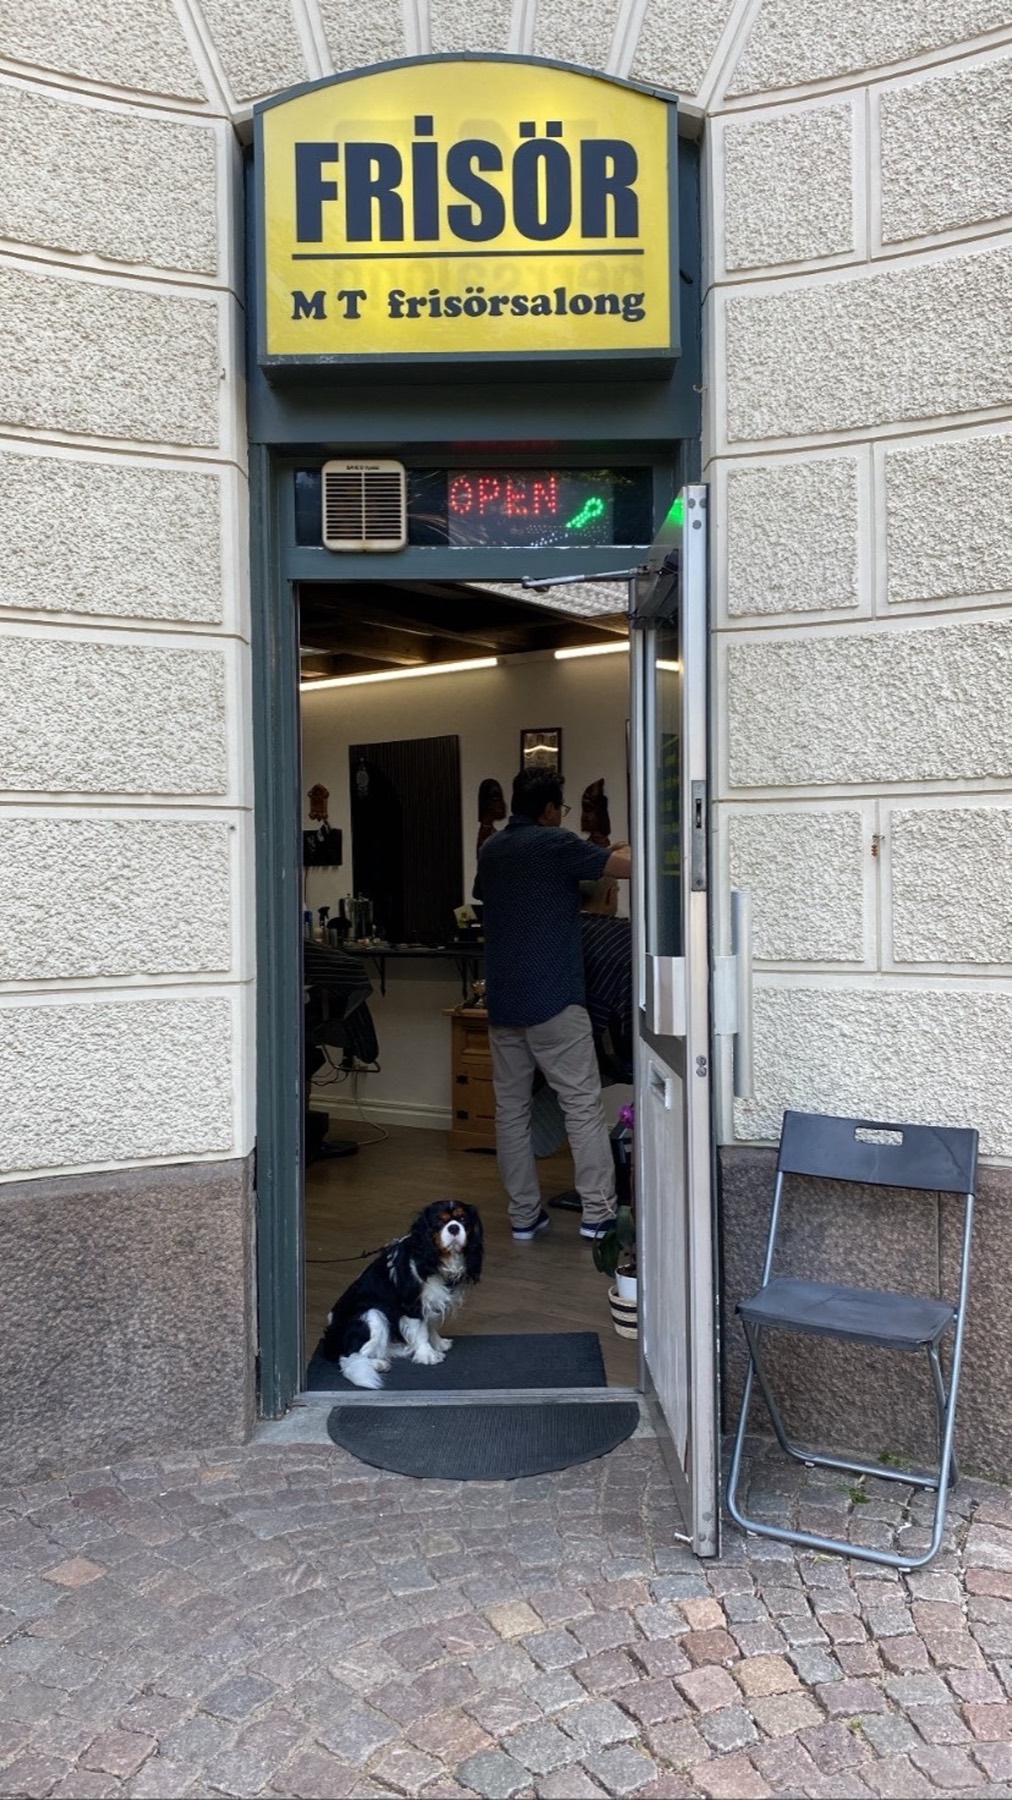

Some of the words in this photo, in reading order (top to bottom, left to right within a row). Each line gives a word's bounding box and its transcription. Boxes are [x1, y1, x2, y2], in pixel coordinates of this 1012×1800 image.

[291, 290, 327, 321] M
[338, 289, 367, 319] T
[387, 286, 646, 322] frisörsalong
[450, 476, 558, 515] OPEN
